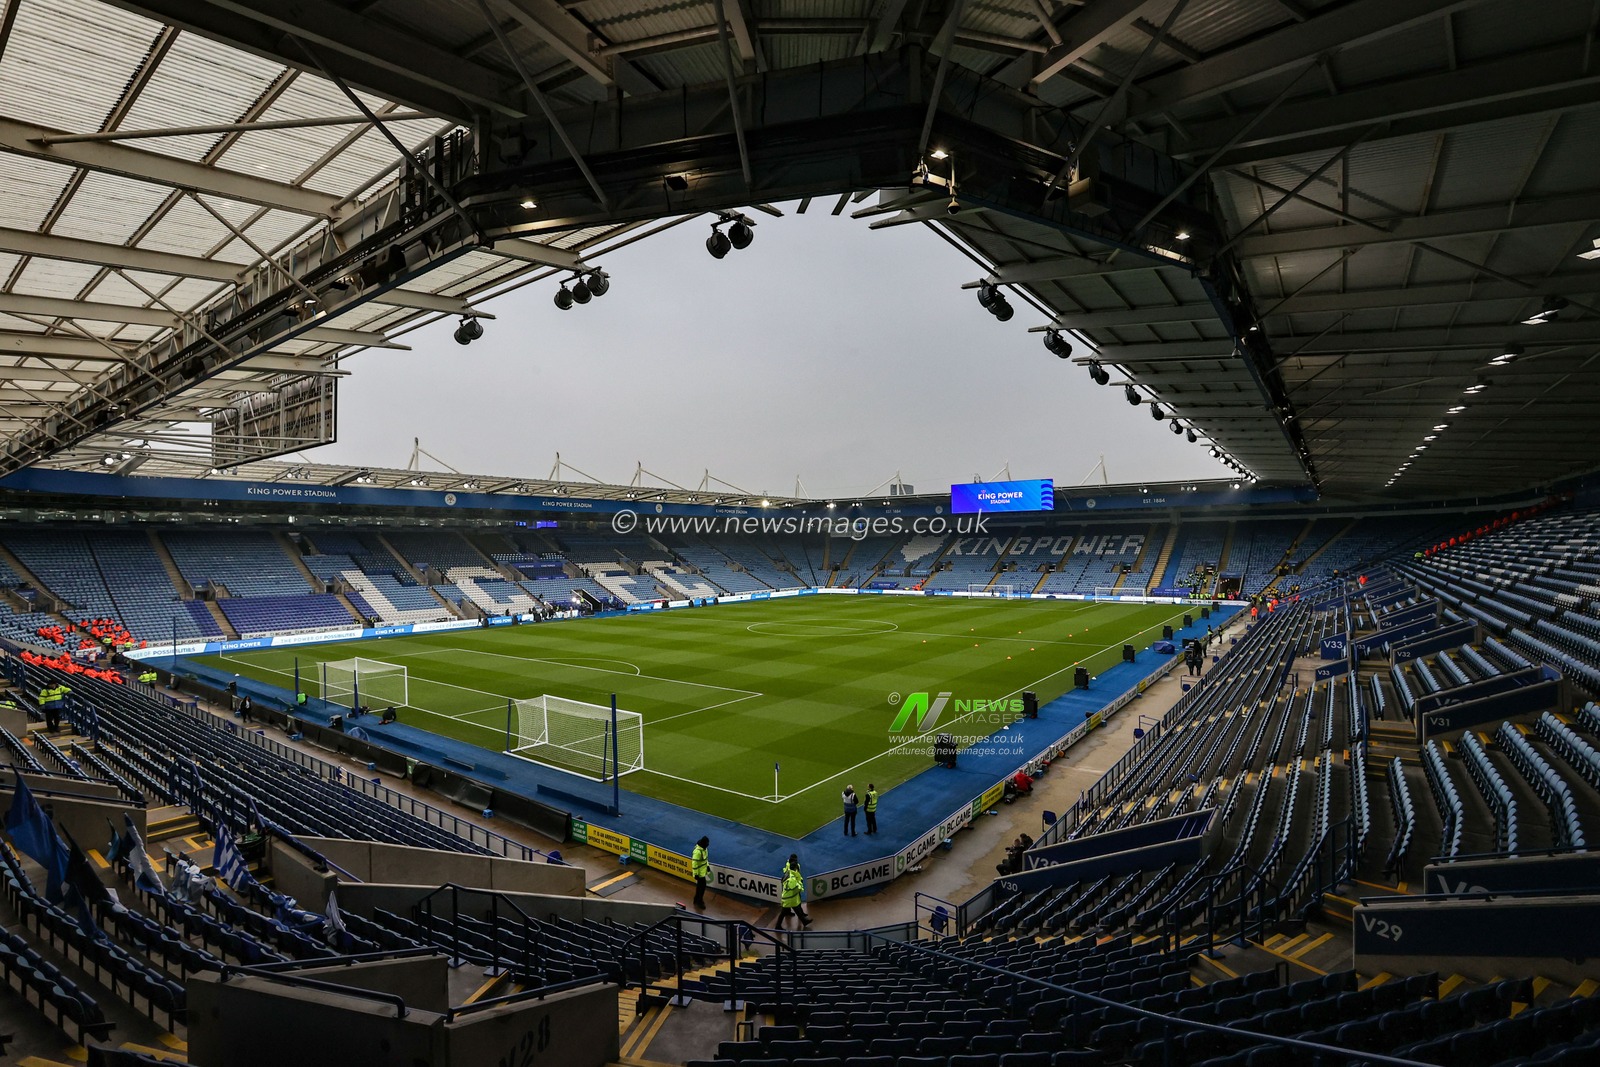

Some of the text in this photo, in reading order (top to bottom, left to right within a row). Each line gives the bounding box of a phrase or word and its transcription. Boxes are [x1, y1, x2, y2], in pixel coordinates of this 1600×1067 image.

[247, 487, 337, 498] KING POWER STADIUM
[978, 491, 1023, 500] KING POWER
[1323, 640, 1343, 649] V33
[1430, 716, 1450, 727] V31
[946, 807, 971, 834] BC.GAME
[906, 833, 936, 864] BC.GAME
[717, 872, 778, 897] BC.GAME
[831, 864, 890, 891] BC.GAME
[1000, 880, 1018, 892] V30
[1360, 913, 1403, 942] V29
